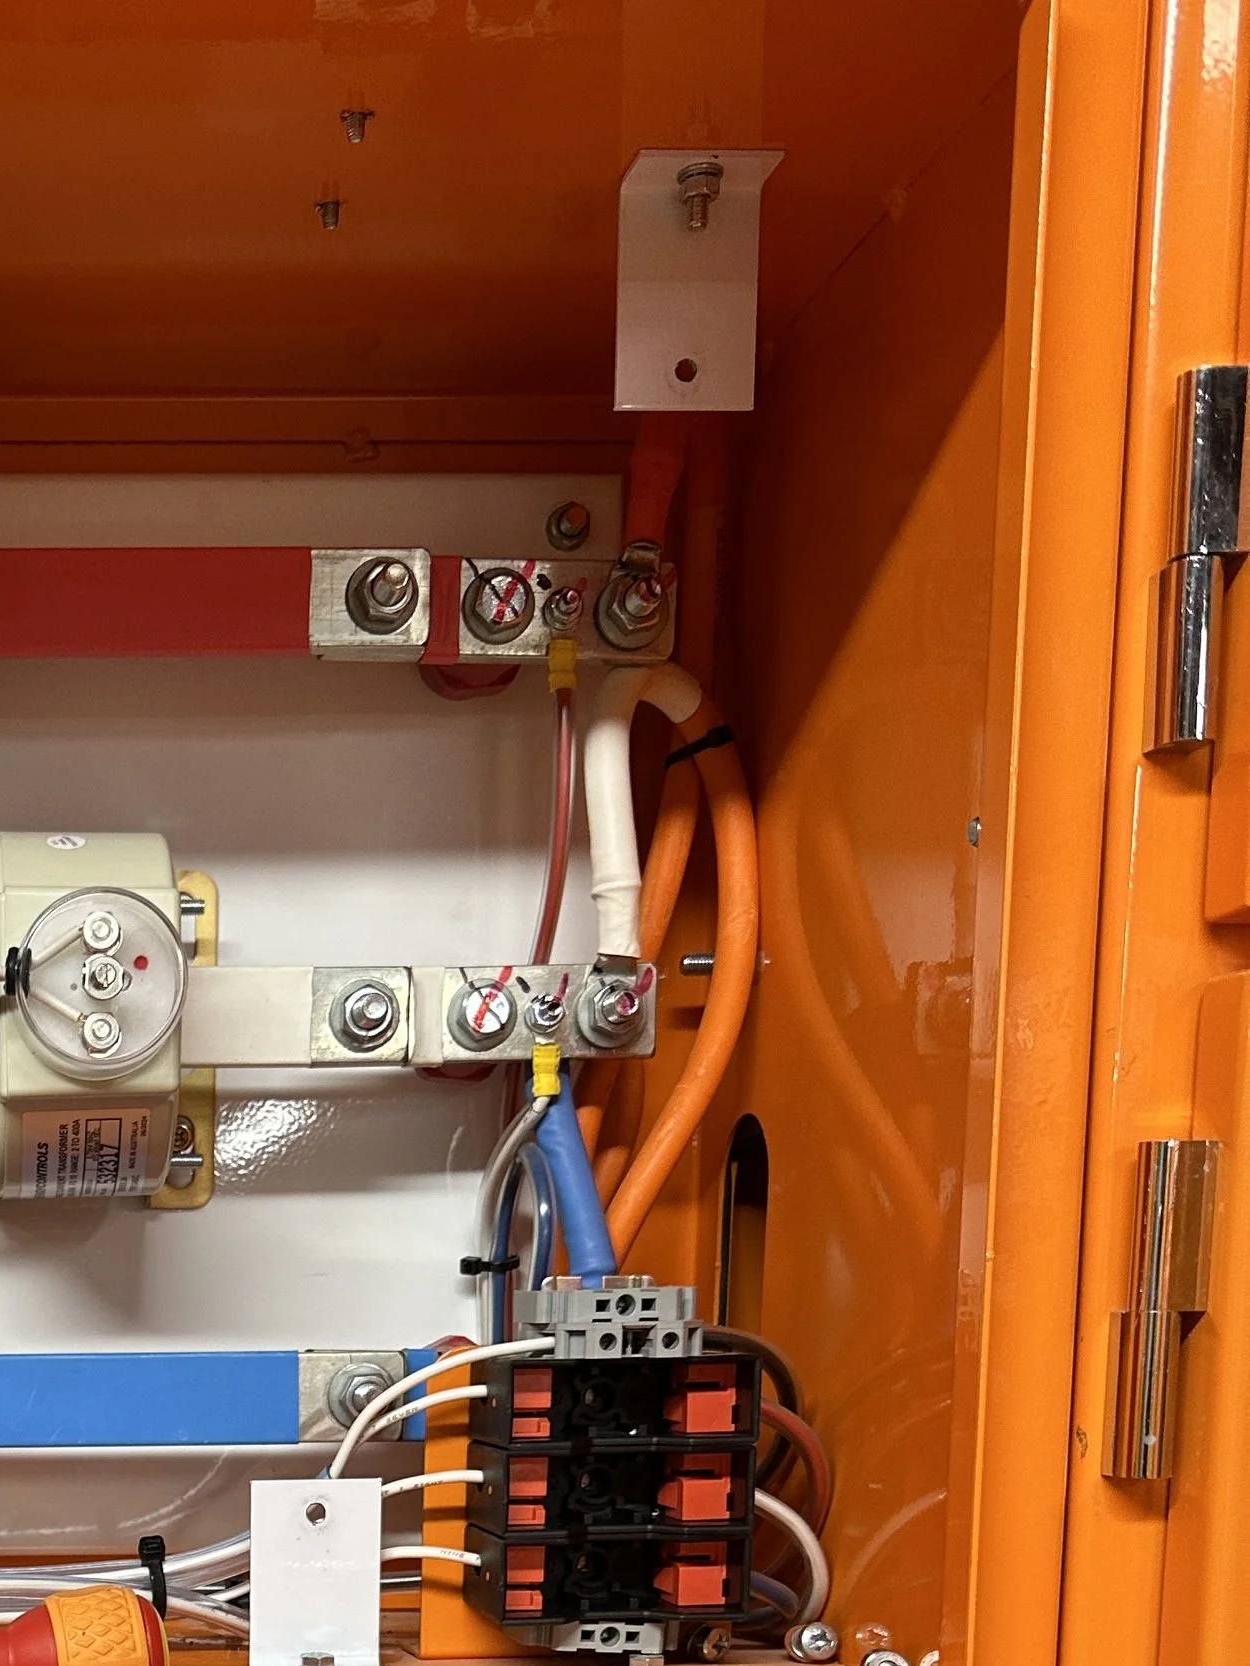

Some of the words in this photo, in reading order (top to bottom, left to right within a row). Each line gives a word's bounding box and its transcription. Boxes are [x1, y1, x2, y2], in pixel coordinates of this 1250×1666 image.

[71, 1118, 81, 1136] 400A
[71, 1137, 80, 1148] TO
[130, 1120, 139, 1153] AUSTRALIA
[57, 1123, 68, 1174] TRANSFORMER
[97, 1143, 120, 1185] 532317
[386, 1406, 419, 1424] SEVEN
[439, 1549, 465, 1559] NINE
